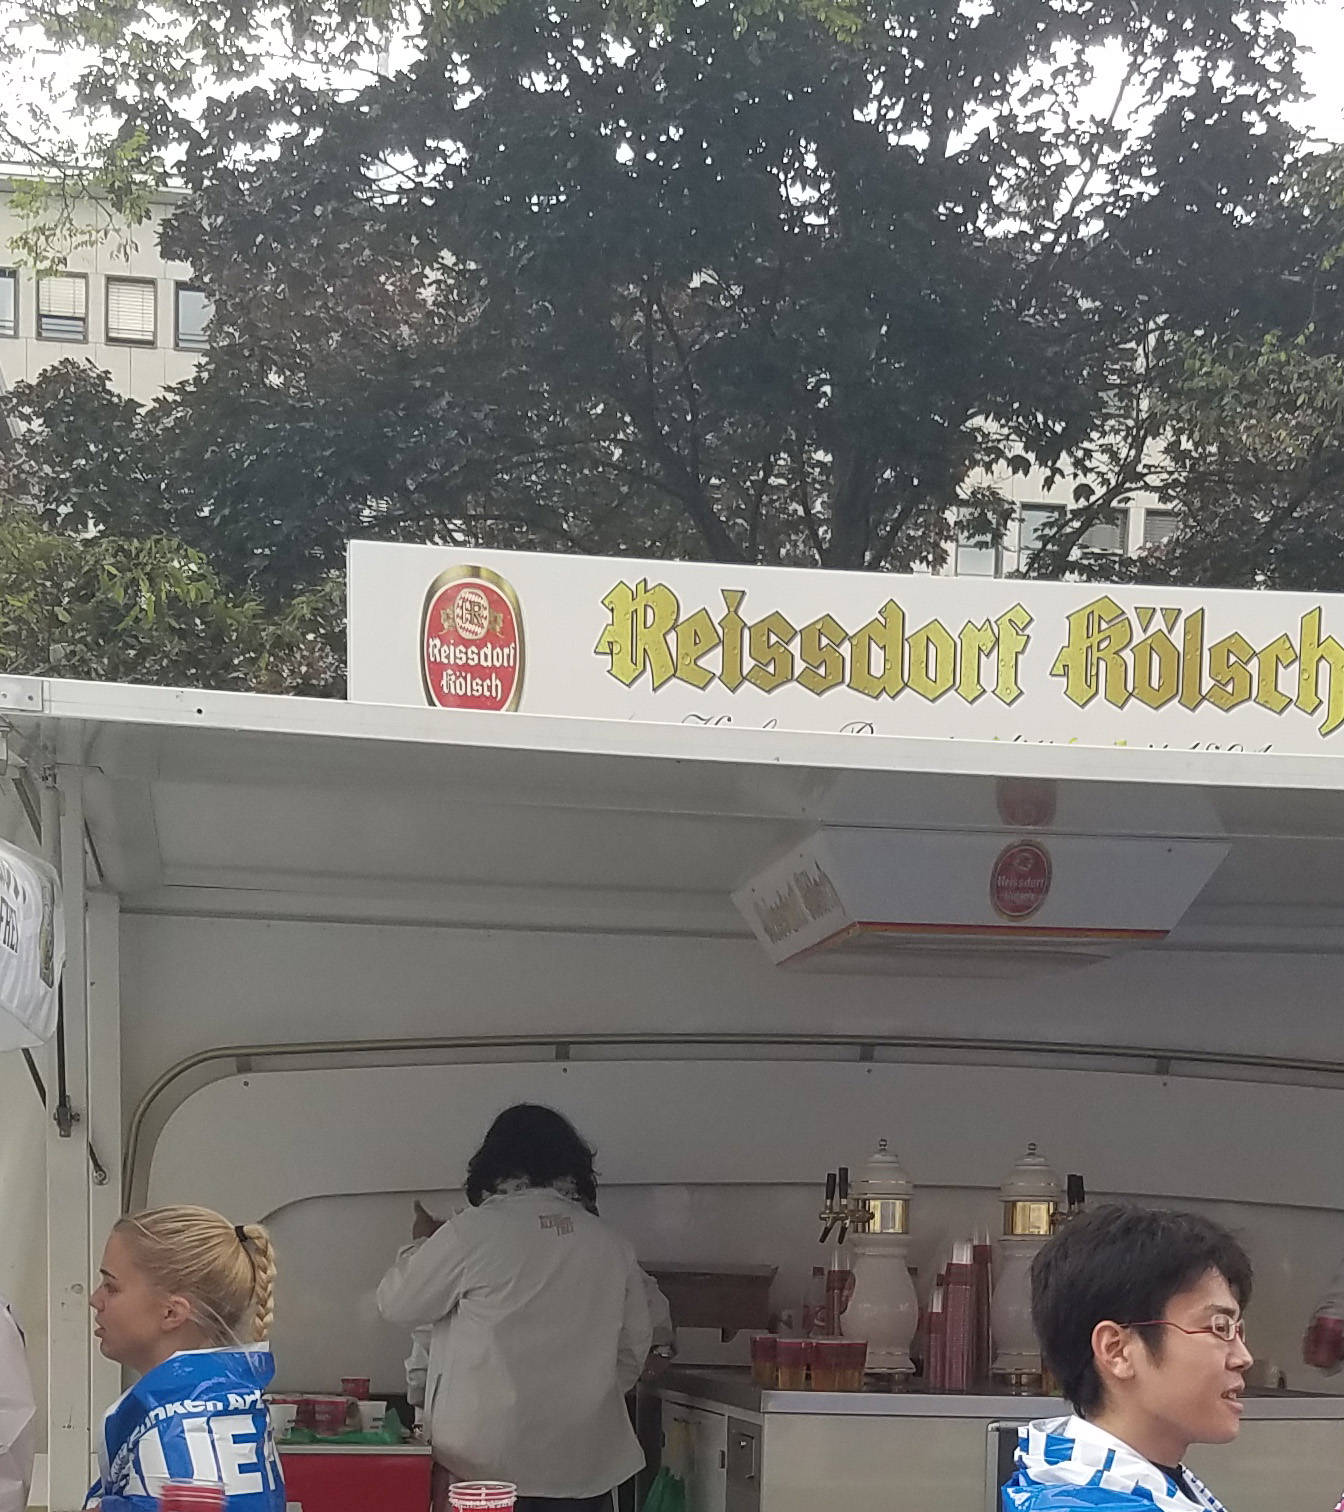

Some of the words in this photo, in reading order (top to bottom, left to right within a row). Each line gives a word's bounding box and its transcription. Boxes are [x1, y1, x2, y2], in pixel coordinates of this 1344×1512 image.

[428, 637, 518, 668] Reissdorf
[594, 578, 1032, 706] Reissdorf
[441, 670, 503, 701] Kölsch
